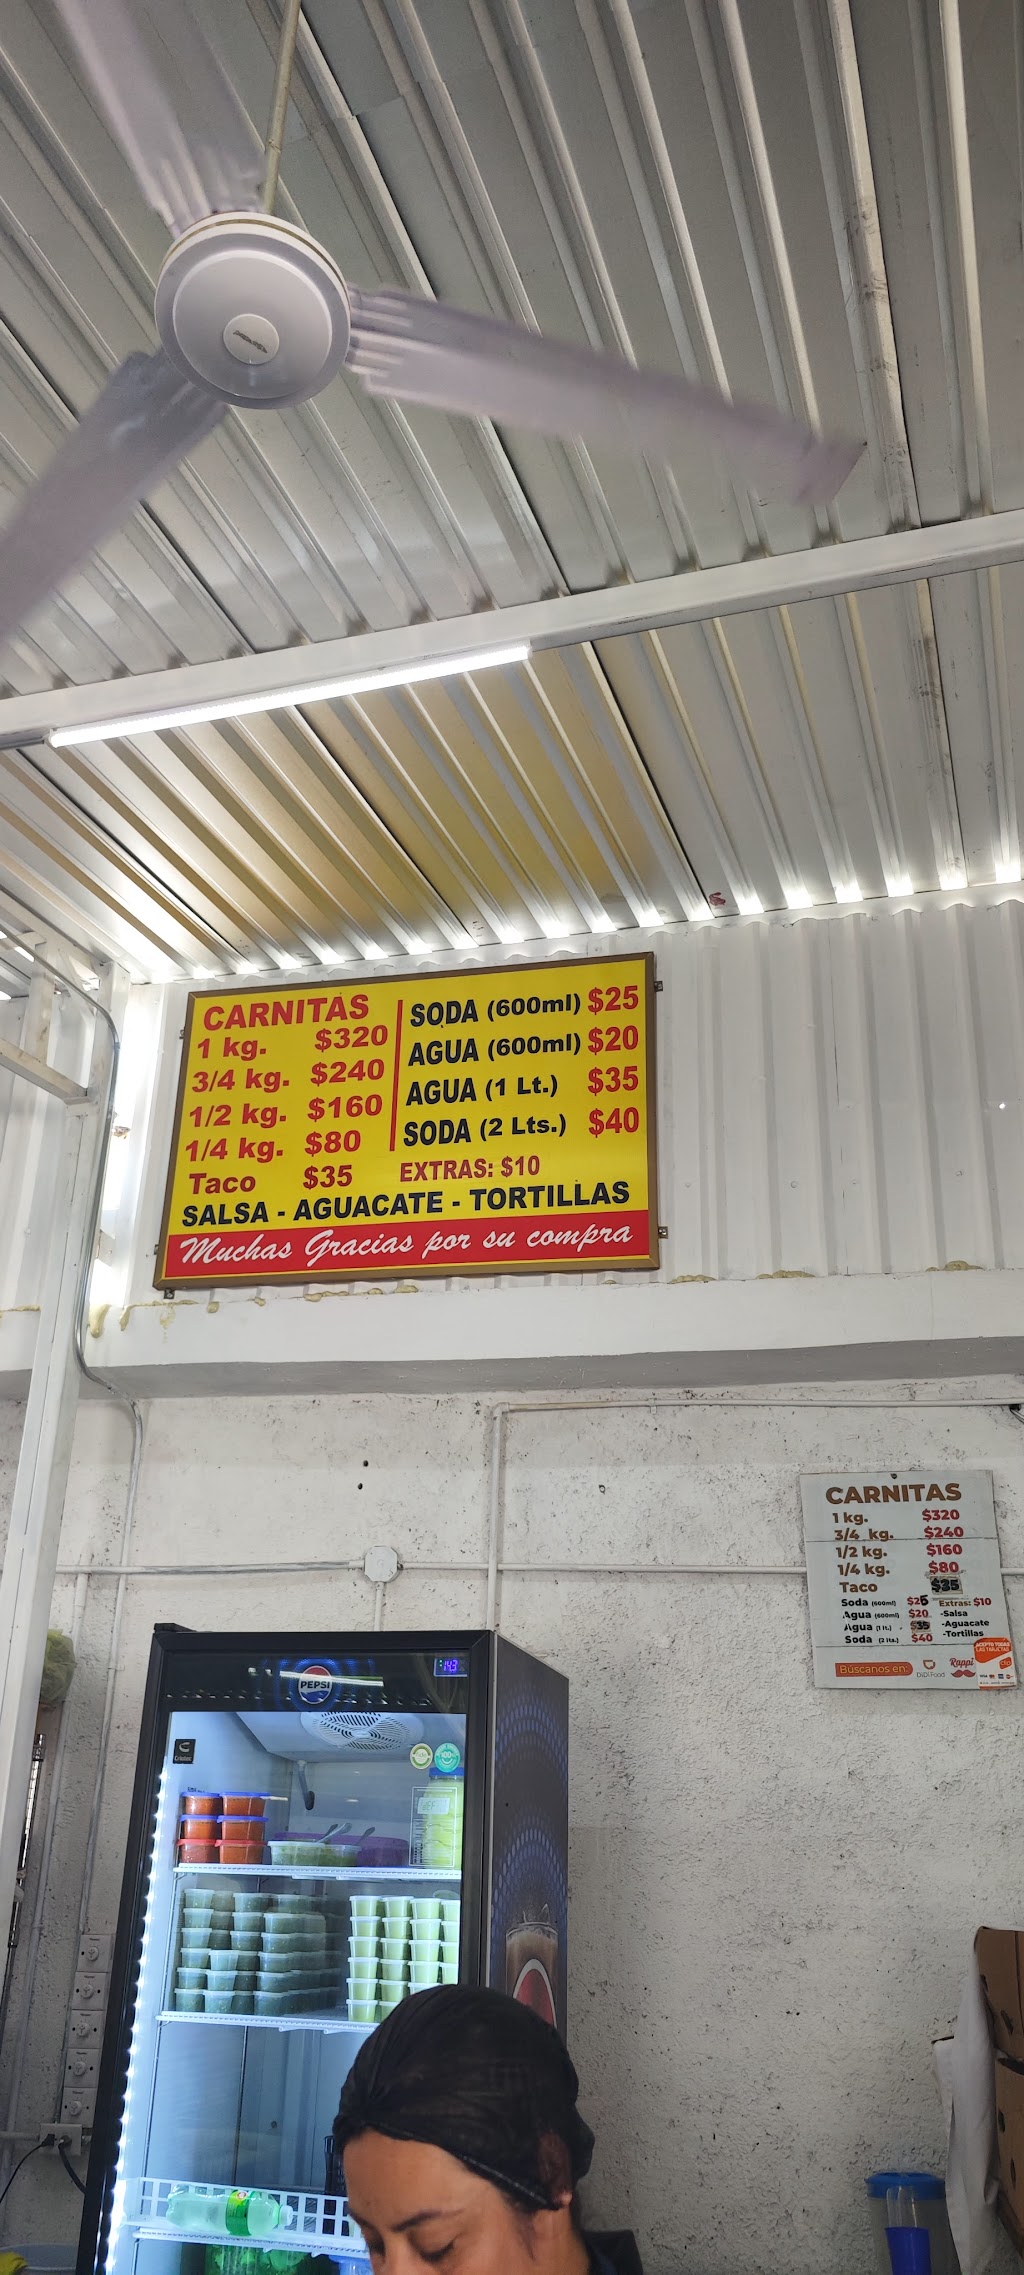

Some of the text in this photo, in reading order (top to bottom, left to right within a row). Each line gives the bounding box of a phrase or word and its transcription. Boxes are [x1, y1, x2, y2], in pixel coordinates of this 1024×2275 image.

[203, 994, 369, 1031] CARNITAS
[410, 985, 639, 1027] SODA (600ml) $25
[197, 1025, 388, 1061] 1 kg. $320
[408, 1025, 639, 1066] AGUA (600ml) $20
[192, 1059, 384, 1093] 3/4 kg. $240
[406, 1066, 639, 1106] AGUA (1 Lt.) $35
[189, 1094, 383, 1128] 1/2 kg. $160
[403, 1107, 639, 1147] SODA (2 Lts.) $40
[186, 1130, 361, 1163] 1/4 kg. $80
[400, 1155, 540, 1182] EXTRAS: $10
[189, 1164, 353, 1195] Taco $35
[182, 1202, 268, 1227] SALSA
[293, 1191, 443, 1221] AGUACATE
[470, 1181, 630, 1211] TORTILLAS
[180, 1223, 633, 1267] Muchas Gracias por su compra
[826, 1483, 962, 1504] CARNITAS
[833, 1508, 960, 1525] 1 kg. $320
[834, 1526, 964, 1542] 3/4 kg. $240
[836, 1543, 962, 1559] 1/2 kg. $160
[838, 1561, 959, 1577] 1/4 kg. $80
[839, 1578, 960, 1593] Taco $35
[842, 1598, 868, 1607] Soda
[974, 1597, 992, 1607] $10
[843, 1611, 871, 1620] Agua
[909, 1609, 928, 1618] $20
[942, 1620, 989, 1628] -Aguacate
[844, 1624, 872, 1632] Agua
[910, 1620, 930, 1631] $35
[845, 1635, 872, 1644] Soda
[912, 1633, 932, 1643] $40
[840, 1665, 890, 1674] Búscanos
[950, 1658, 974, 1668] Rappi
[300, 1681, 330, 1689] PEPSI
